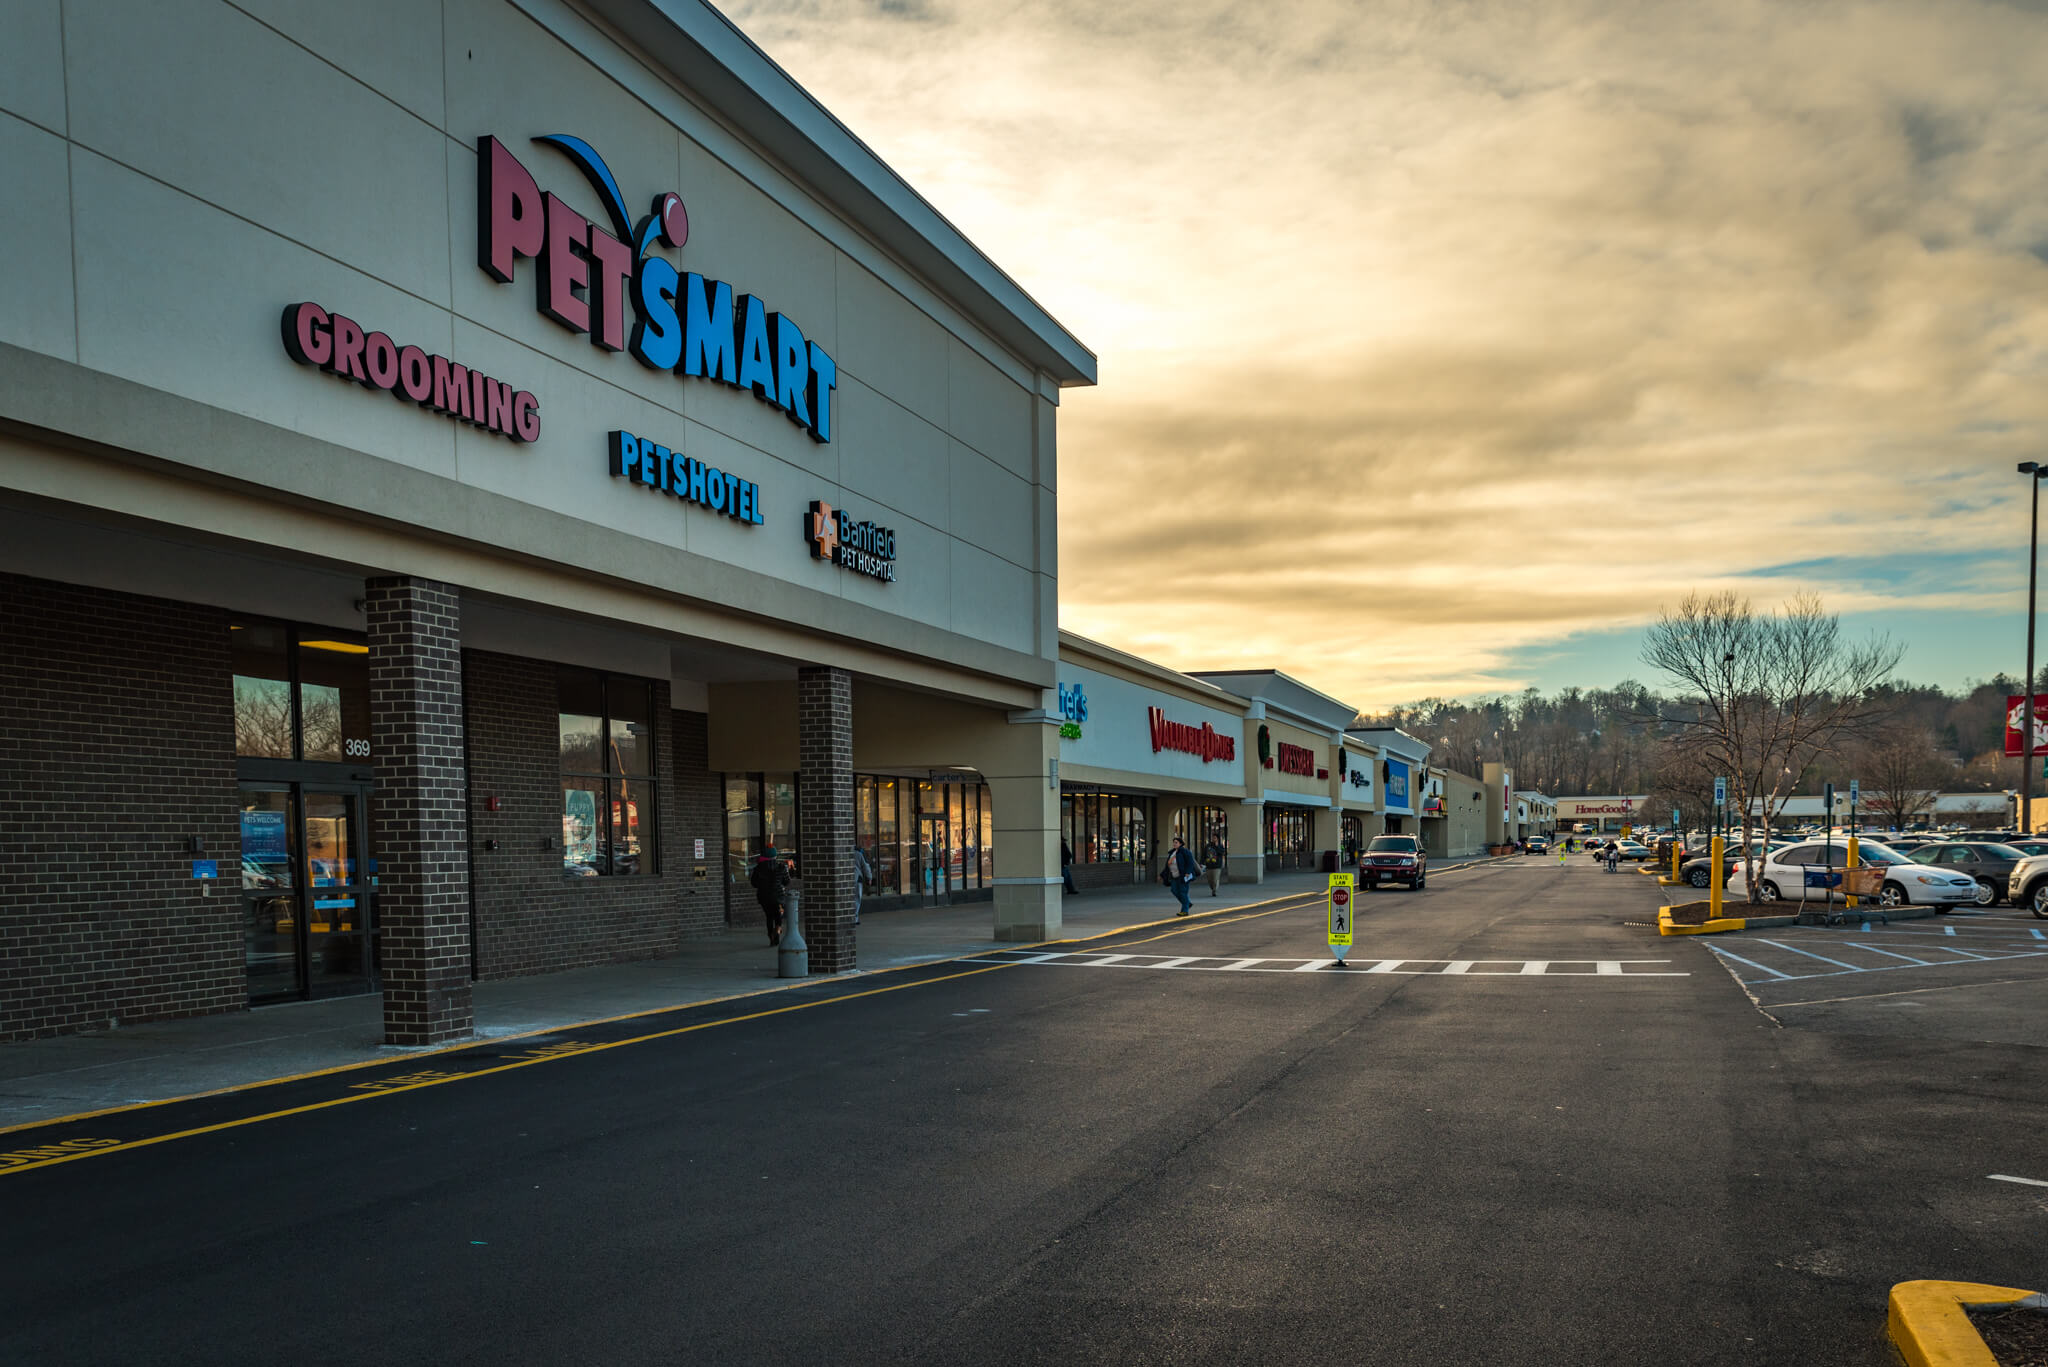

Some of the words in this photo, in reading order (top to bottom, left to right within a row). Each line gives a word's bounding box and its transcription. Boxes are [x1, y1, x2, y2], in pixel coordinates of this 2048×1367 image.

[283, 301, 540, 443] GROOMING
[608, 430, 764, 525] PETSHOTEL
[840, 510, 896, 560] Banfield
[841, 546, 857, 569] PET
[858, 552, 897, 582] HOSPITAL
[346, 738, 371, 757] 369
[257, 816, 282, 824] WELCOME
[1576, 804, 1628, 814] HomeGood
[348, 1070, 467, 1091] FIRE
[499, 1040, 608, 1060] LANE
